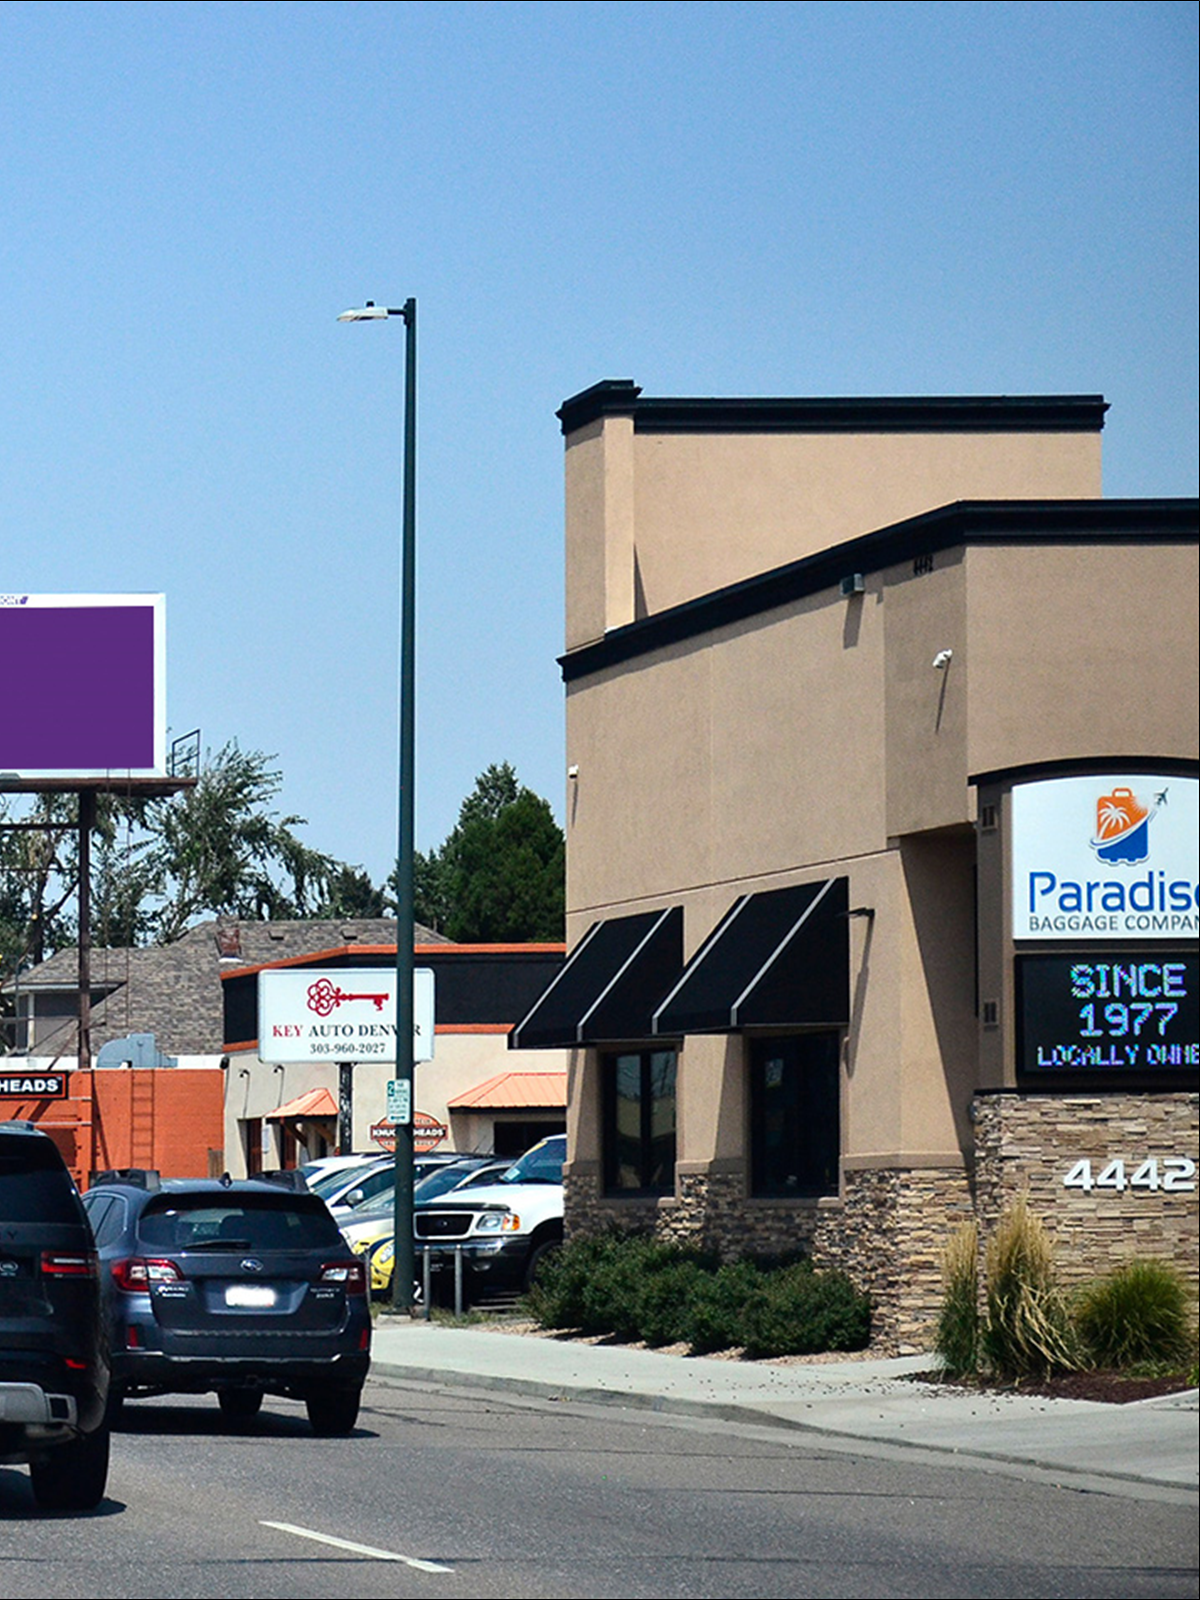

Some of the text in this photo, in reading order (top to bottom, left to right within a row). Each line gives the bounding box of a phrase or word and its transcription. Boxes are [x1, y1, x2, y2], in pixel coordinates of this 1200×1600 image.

[1029, 871, 1199, 913] Paradis
[1029, 915, 1119, 931] BAGGAGE
[1070, 963, 1188, 998] SINCE
[272, 1024, 422, 1037] KEY AUTO DENVR
[1079, 1002, 1178, 1037] 1977
[309, 1043, 386, 1054] 303-960-2027
[1037, 1044, 1139, 1066] LOCALLY
[1063, 1159, 1196, 1191] 4442
